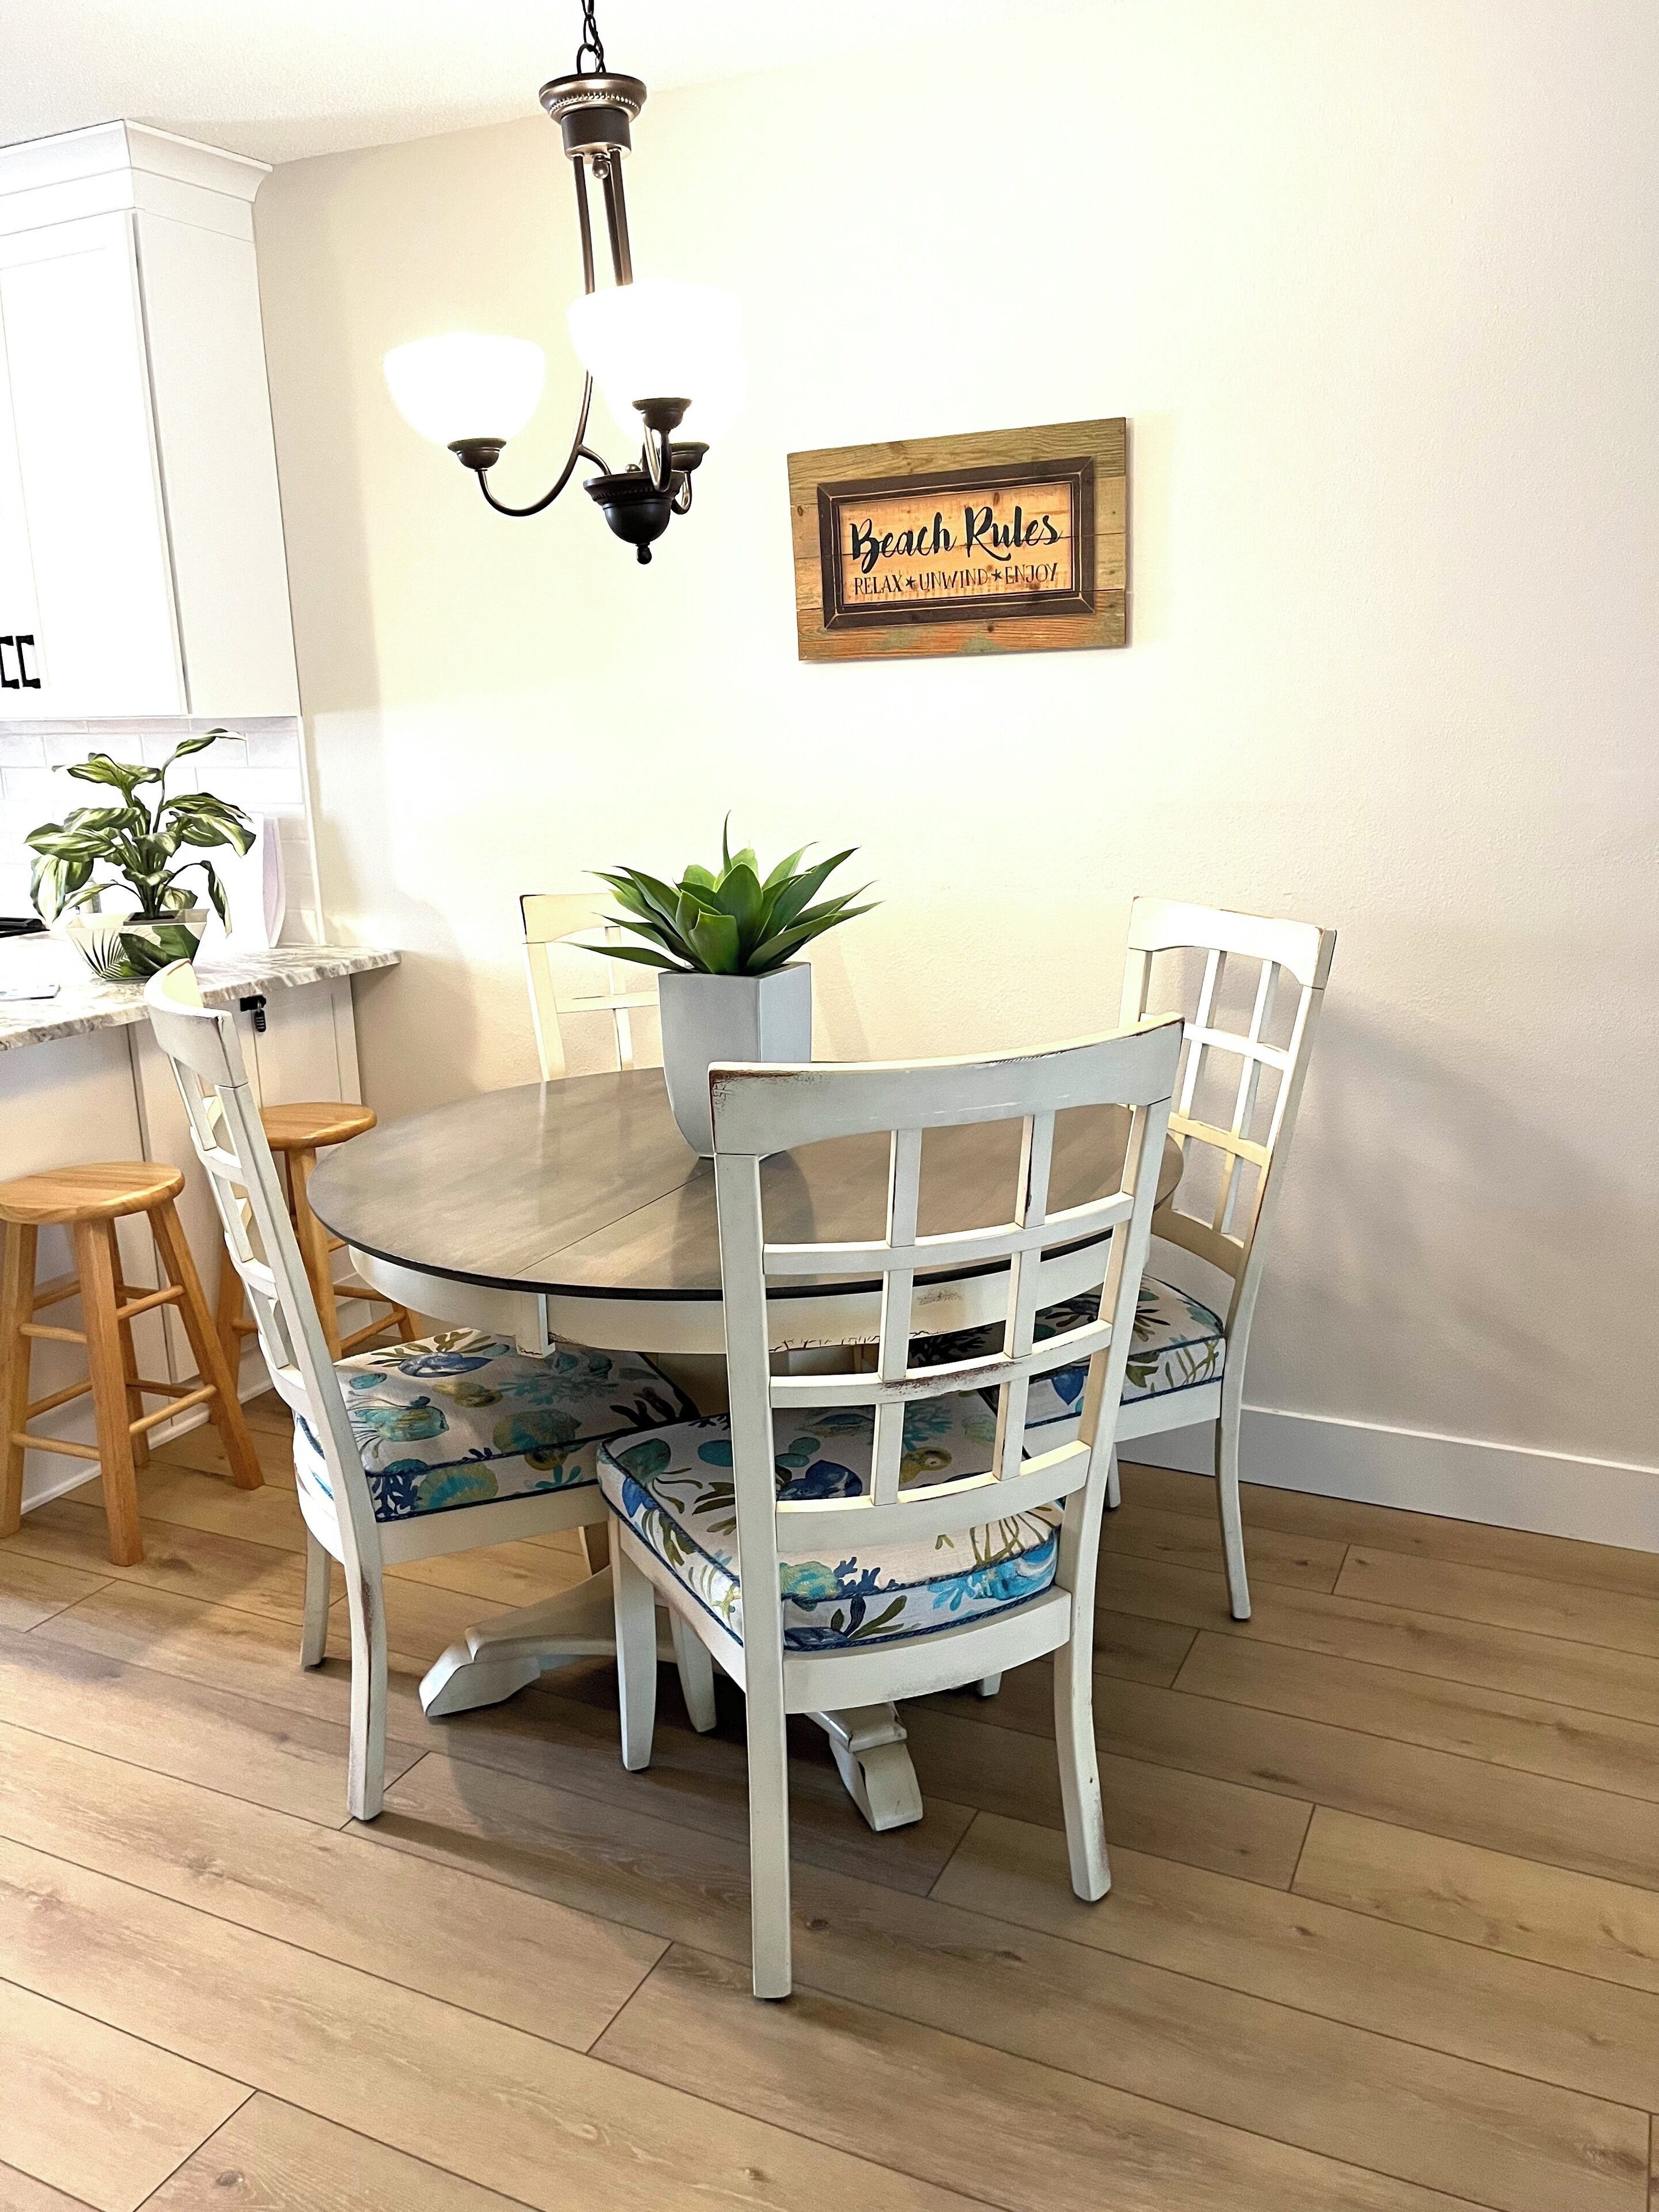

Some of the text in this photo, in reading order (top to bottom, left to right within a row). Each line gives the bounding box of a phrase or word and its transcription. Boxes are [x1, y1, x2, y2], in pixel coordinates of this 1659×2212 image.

[850, 506, 1063, 574] Beach Rules
[854, 563, 1058, 595] RELAX UNWIND ENJOY
